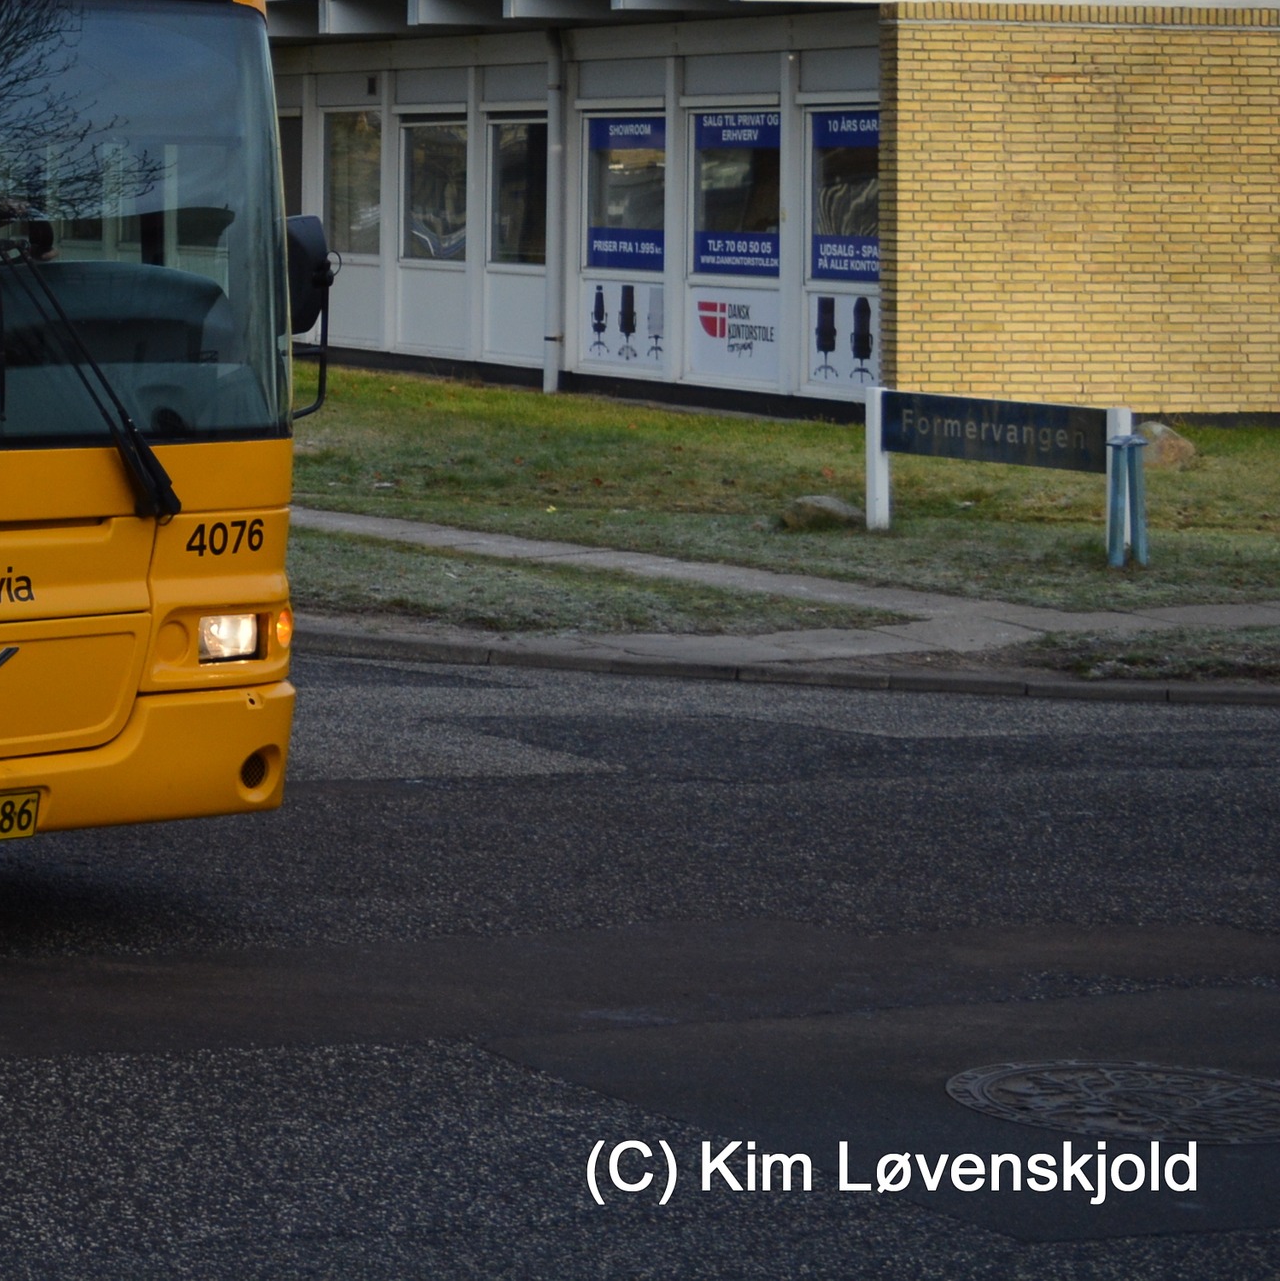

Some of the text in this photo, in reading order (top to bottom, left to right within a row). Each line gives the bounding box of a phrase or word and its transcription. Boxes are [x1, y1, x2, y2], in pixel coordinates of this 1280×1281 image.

[702, 114, 779, 127] SALG TIL PRIVAT OG
[828, 116, 879, 132] 10 ÅRS GAR
[609, 124, 651, 136] SHOWROOM
[721, 129, 759, 141] ERHVERV
[593, 240, 618, 252] PRISER
[618, 241, 633, 253] FRA
[634, 242, 655, 255] 1.995
[708, 240, 772, 254] TLF: 70 60 50 05
[820, 243, 854, 257] UDSALG
[818, 255, 879, 272] PÅ ALLE KONTO
[727, 303, 751, 320] DANSK
[727, 323, 775, 342] KONTORSTOLE
[901, 408, 1085, 451] Formervangen
[185, 518, 265, 558] 4076
